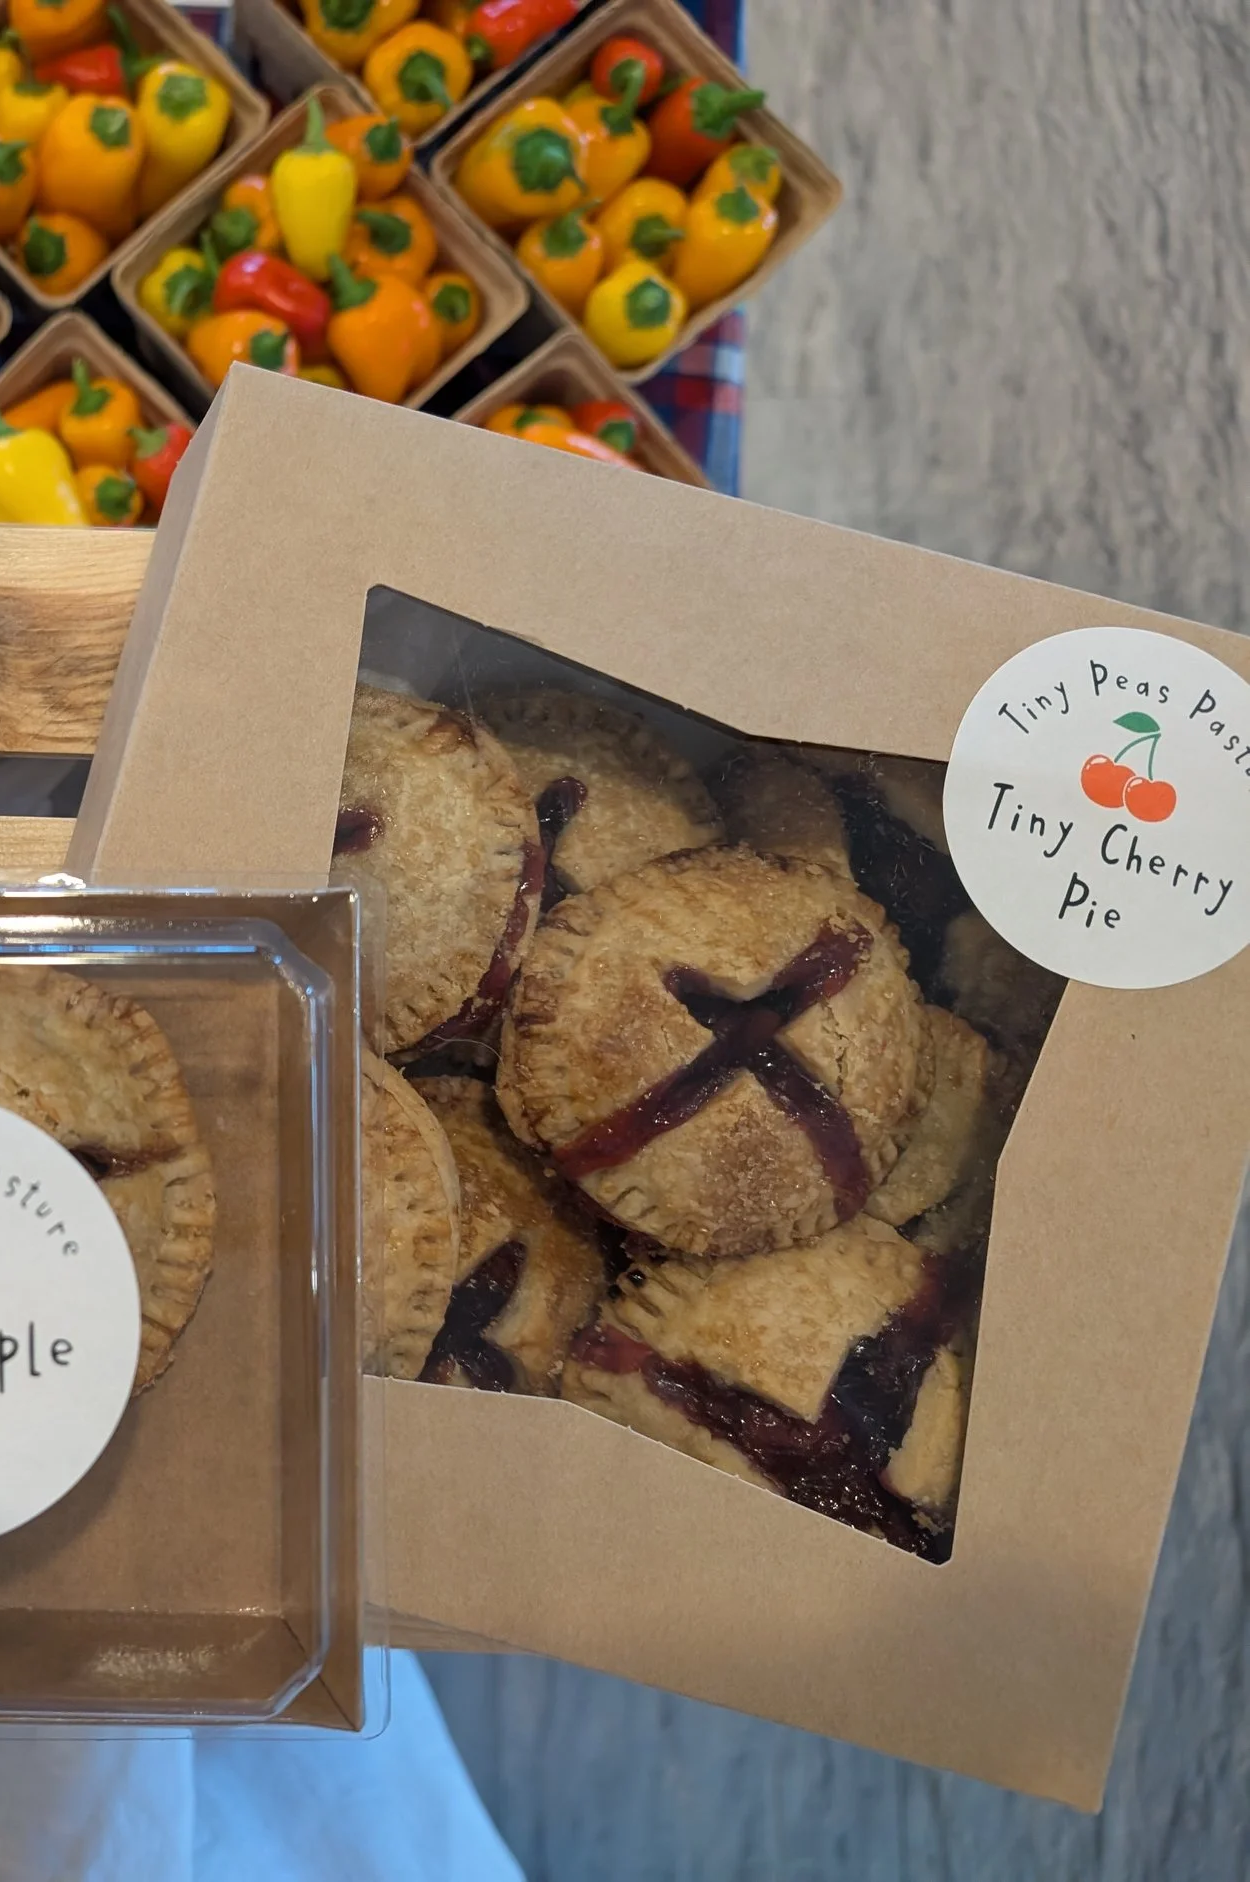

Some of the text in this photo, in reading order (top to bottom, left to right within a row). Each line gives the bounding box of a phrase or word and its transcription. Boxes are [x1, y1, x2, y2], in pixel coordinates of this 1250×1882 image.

[997, 681, 1070, 735] Tiny
[1089, 659, 1170, 704] Peas
[987, 782, 1234, 917] Tiny Cherry
[1057, 871, 1121, 929] Pie
